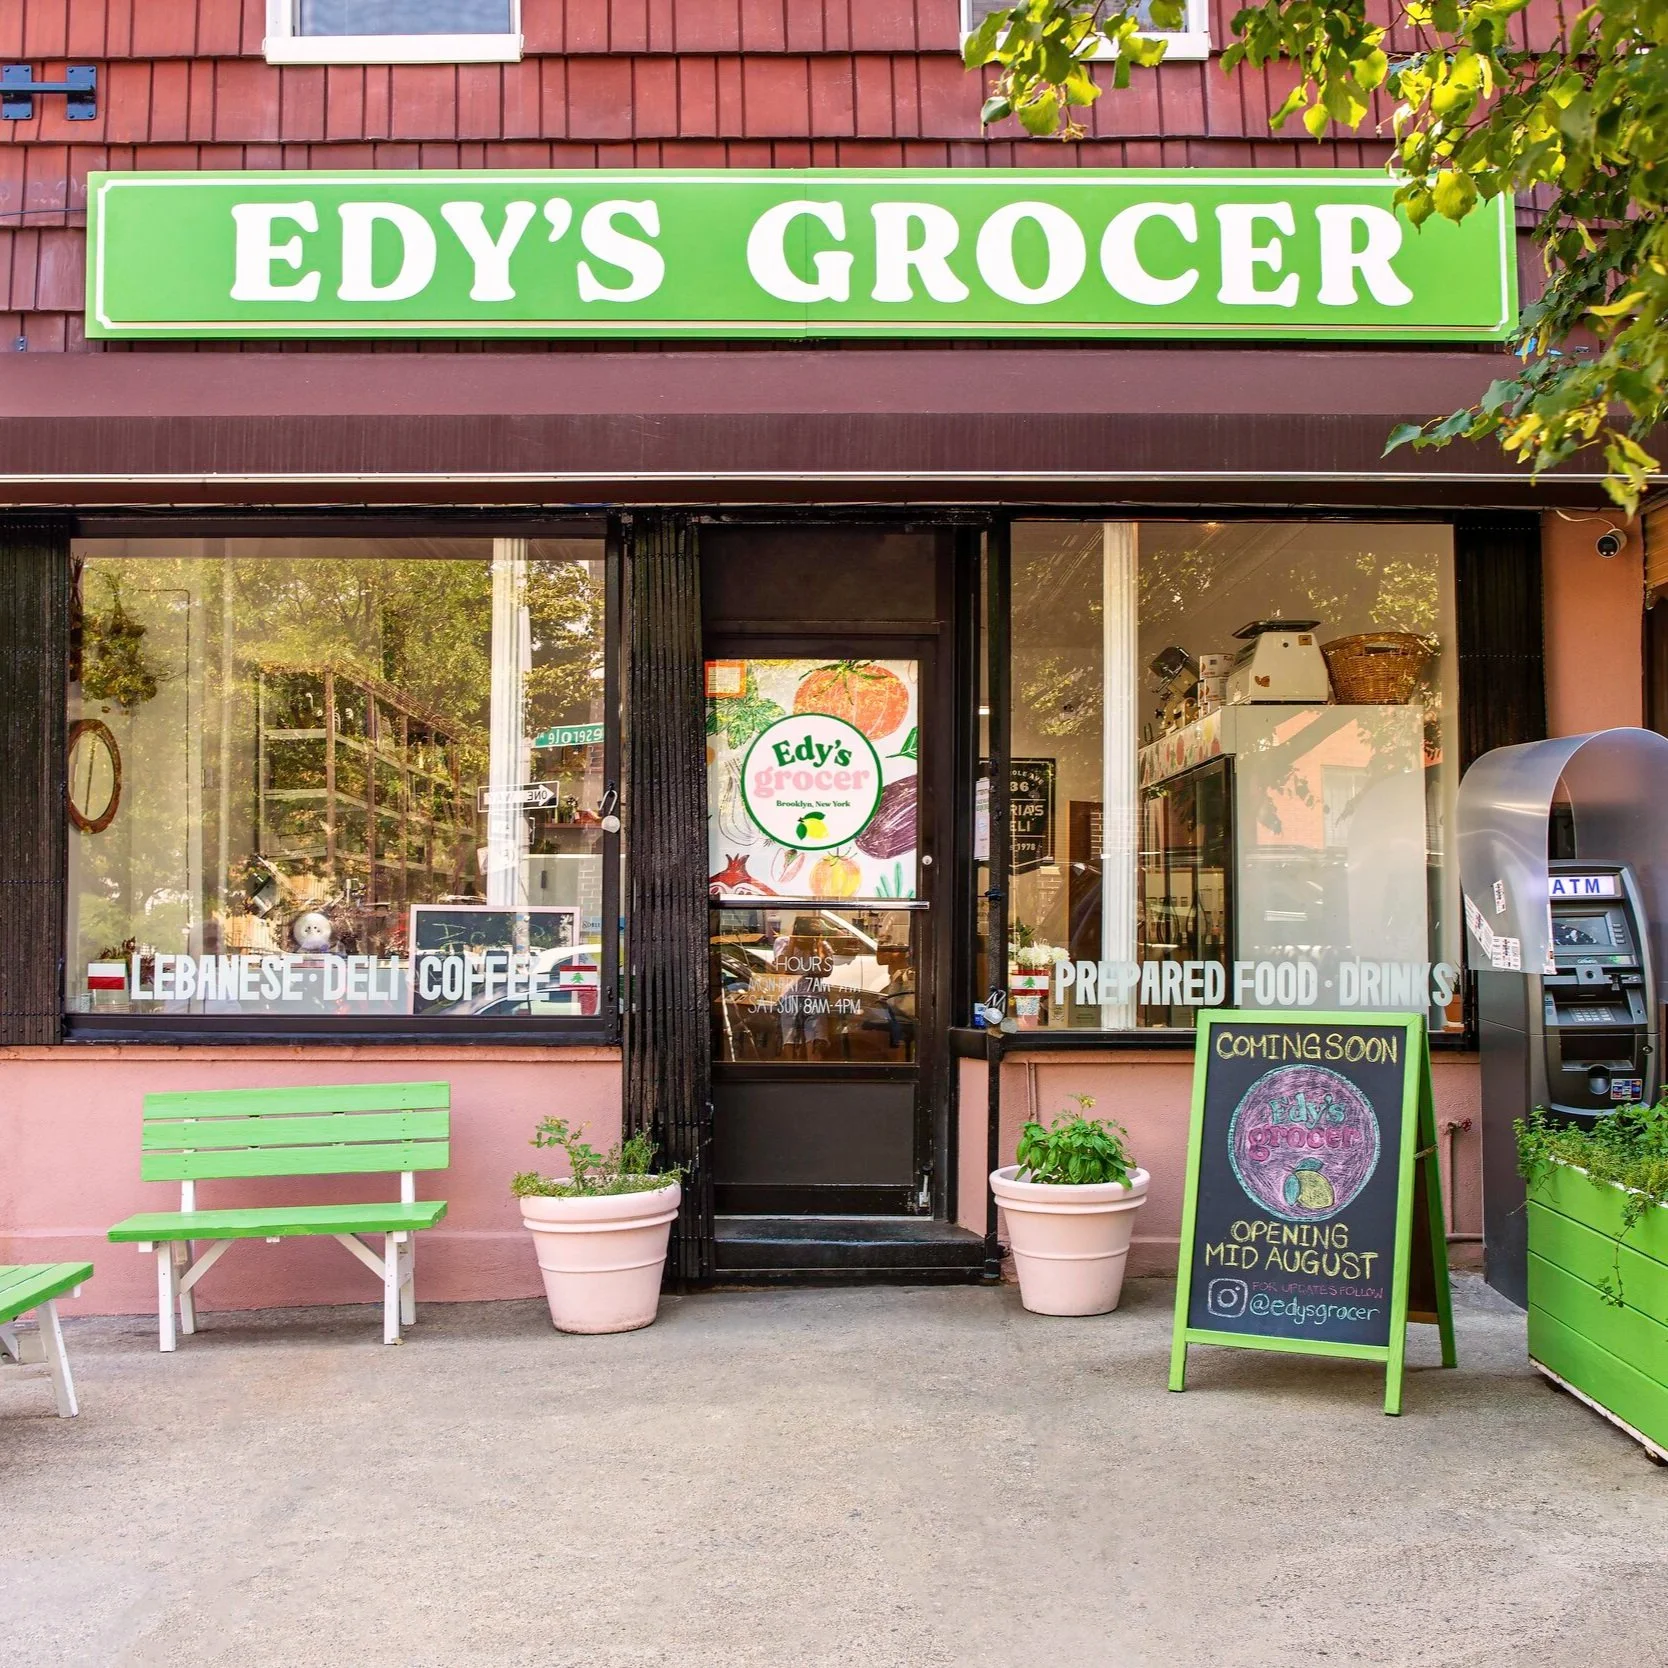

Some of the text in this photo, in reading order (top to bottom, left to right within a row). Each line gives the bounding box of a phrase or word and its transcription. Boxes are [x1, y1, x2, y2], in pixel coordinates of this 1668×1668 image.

[230, 197, 1414, 308] EDY'S GROCER
[771, 734, 853, 769] Edy's
[753, 766, 870, 799] grocer
[776, 800, 814, 809] Brooklyn,
[832, 800, 851, 808] York
[1552, 878, 1601, 894] ATM
[131, 954, 550, 1001] LEBANESE DELI COFFEE
[775, 956, 833, 972] HOURS
[1054, 960, 1454, 1007] PREPARED FOOD DRINKS
[803, 998, 861, 1014] 8AM-4PM
[1269, 1093, 1346, 1129] Edy's
[1249, 1122, 1362, 1162] grocer
[1230, 1220, 1349, 1249] OPENING
[1205, 1242, 1379, 1280] MID AUGUST
[1252, 1281, 1384, 1299] FOR UPDATES FOLLOW
[1249, 1293, 1381, 1325] @edysgrocer
